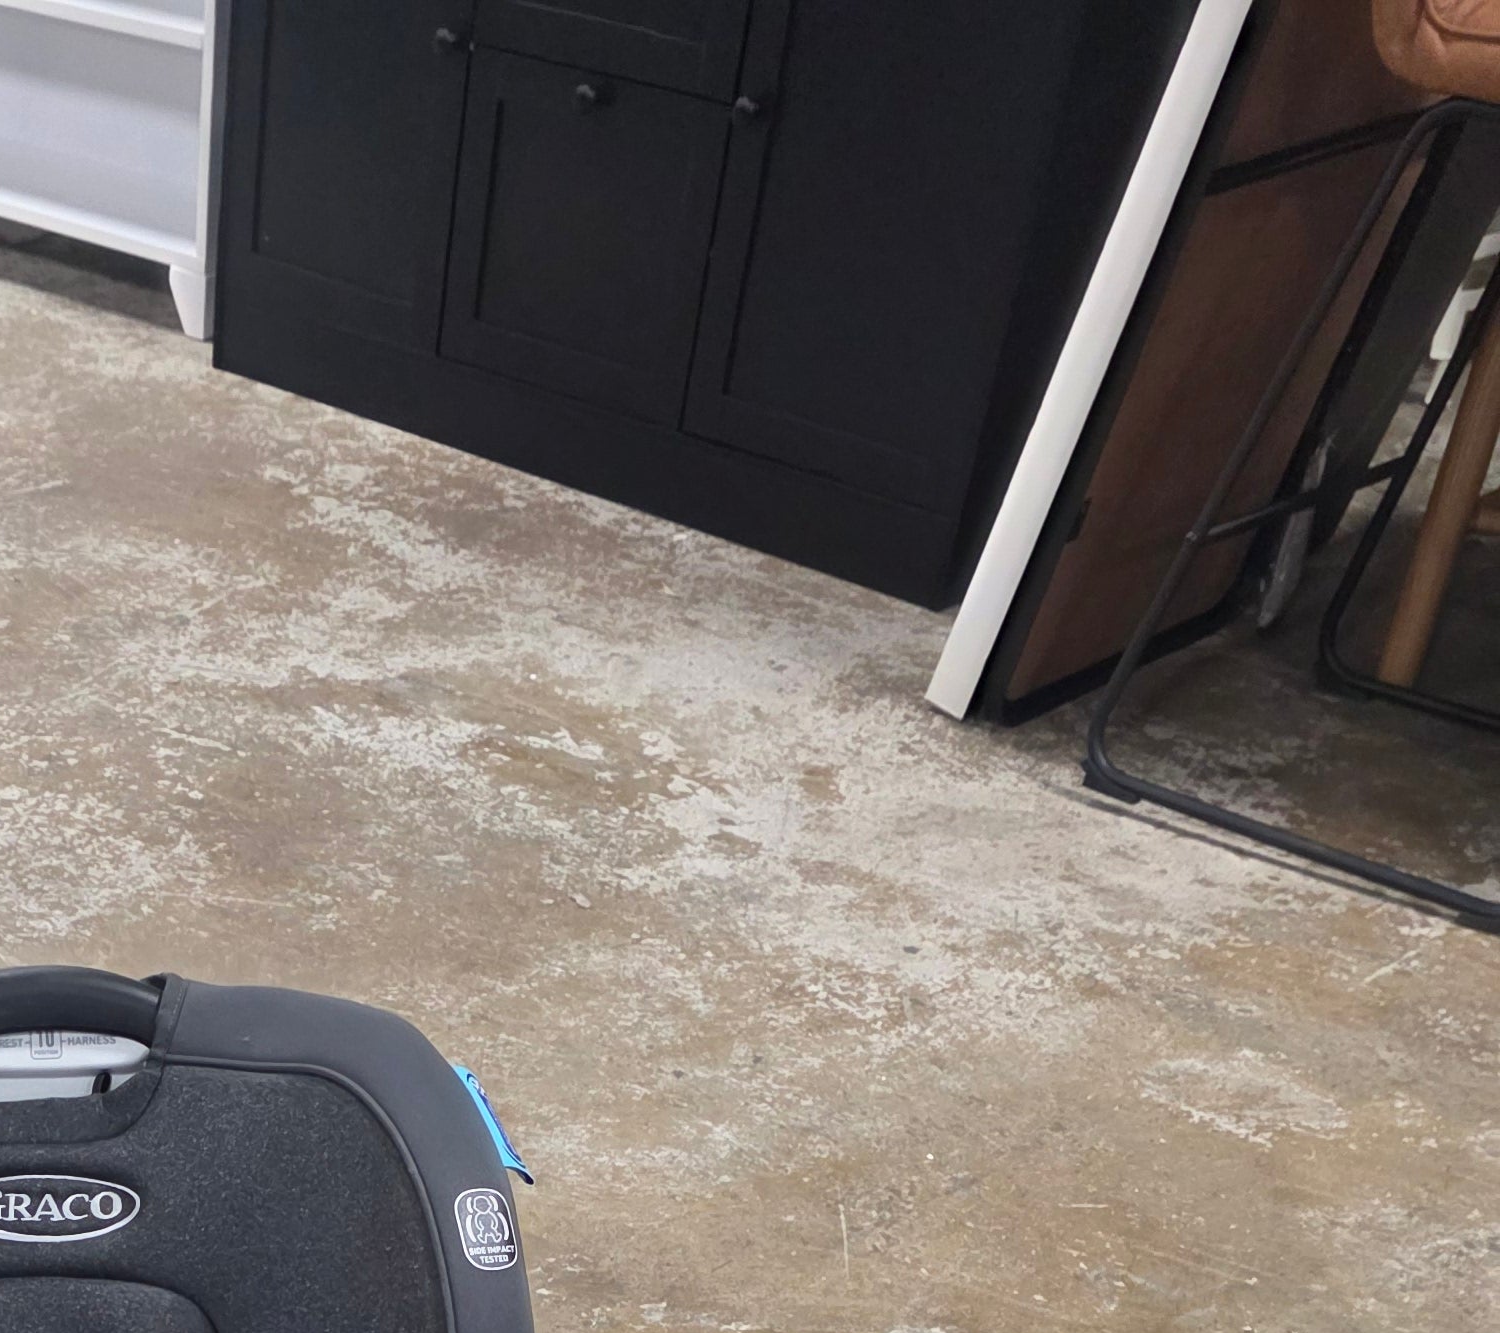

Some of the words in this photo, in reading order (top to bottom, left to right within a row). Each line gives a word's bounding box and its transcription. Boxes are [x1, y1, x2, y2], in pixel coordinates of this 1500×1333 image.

[67, 1035, 117, 1046] HARNESS
[486, 1245, 515, 1254] IMPACT
[479, 1254, 509, 1264] TESTED
